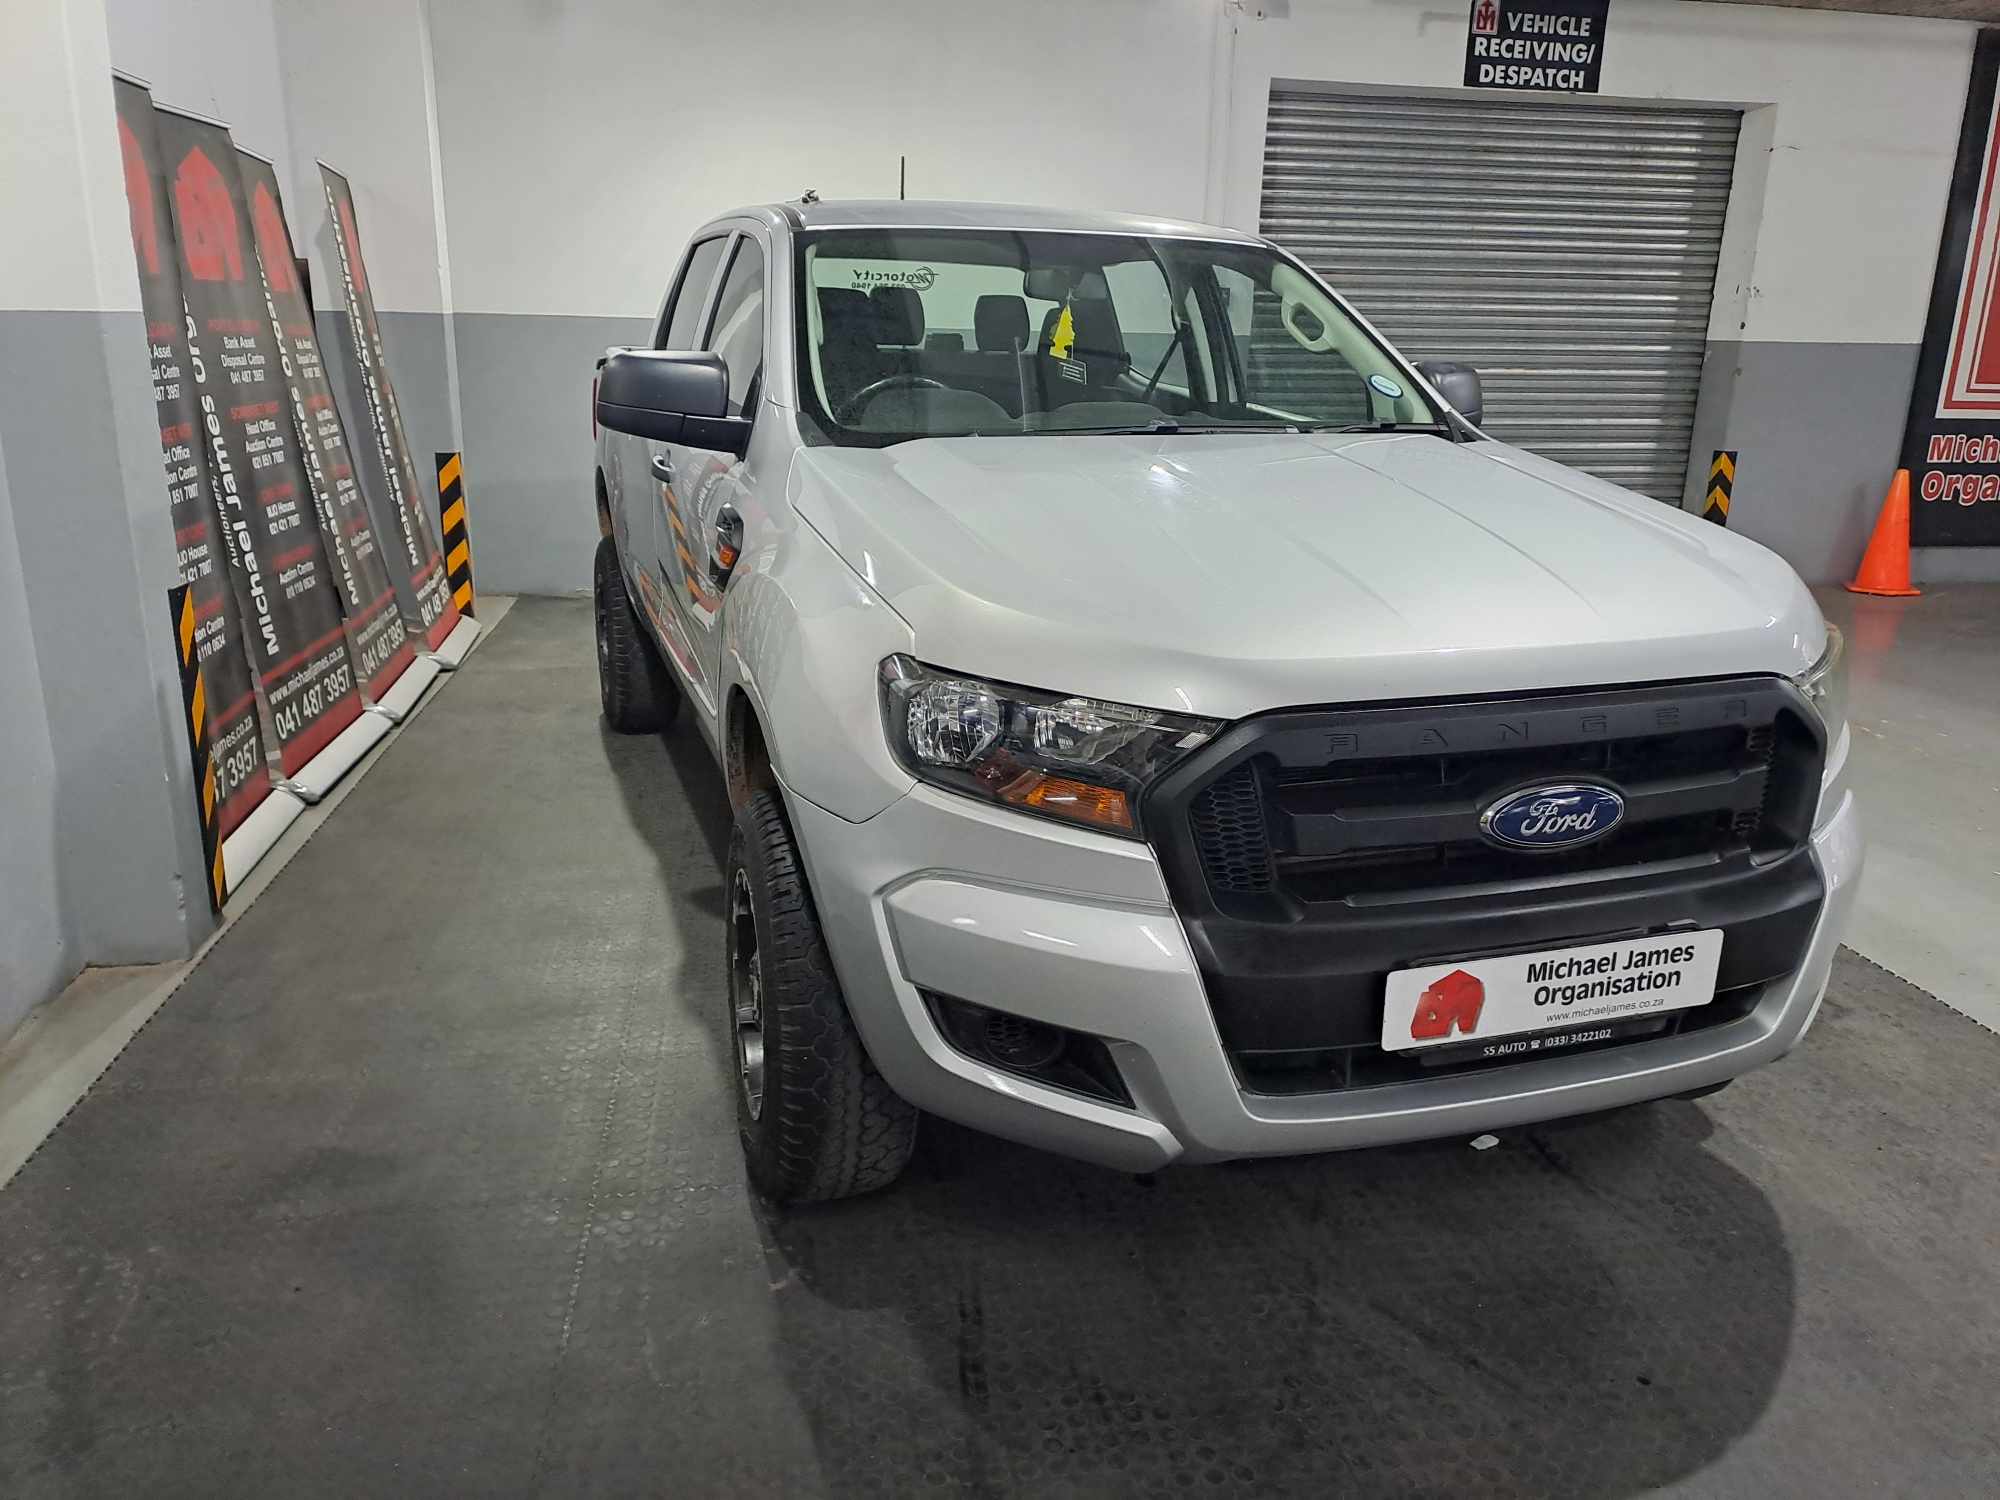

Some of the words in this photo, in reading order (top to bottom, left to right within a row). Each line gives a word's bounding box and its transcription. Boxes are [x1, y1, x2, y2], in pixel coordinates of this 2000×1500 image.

[1507, 12, 1592, 37] VEHICLE
[1474, 37, 1596, 64] RECEIVING/
[1479, 64, 1585, 89] DESPATCH
[201, 394, 242, 511] James
[291, 386, 325, 483] James
[1926, 433, 2000, 463] Mich
[171, 446, 191, 464] Office
[1920, 470, 2000, 506] Orga
[188, 543, 209, 562] House
[320, 492, 359, 605] Michael
[232, 519, 280, 656] Michael
[361, 644, 380, 675] 041
[275, 701, 302, 740] 041
[303, 684, 323, 718] 487
[323, 664, 350, 702] 3957
[1323, 700, 1748, 753] RANGER
[227, 736, 257, 787] 3957
[1520, 796, 1598, 837] Ford
[1526, 951, 1618, 984] Michael
[1622, 945, 1695, 970] James
[1534, 970, 1682, 1007] Organisation
[1546, 998, 1665, 1024] www.michaeljames.co.za
[1497, 1041, 1527, 1055] AUTO
[1544, 1036, 1569, 1048] (033)
[1570, 1029, 1612, 1045] 3422102
